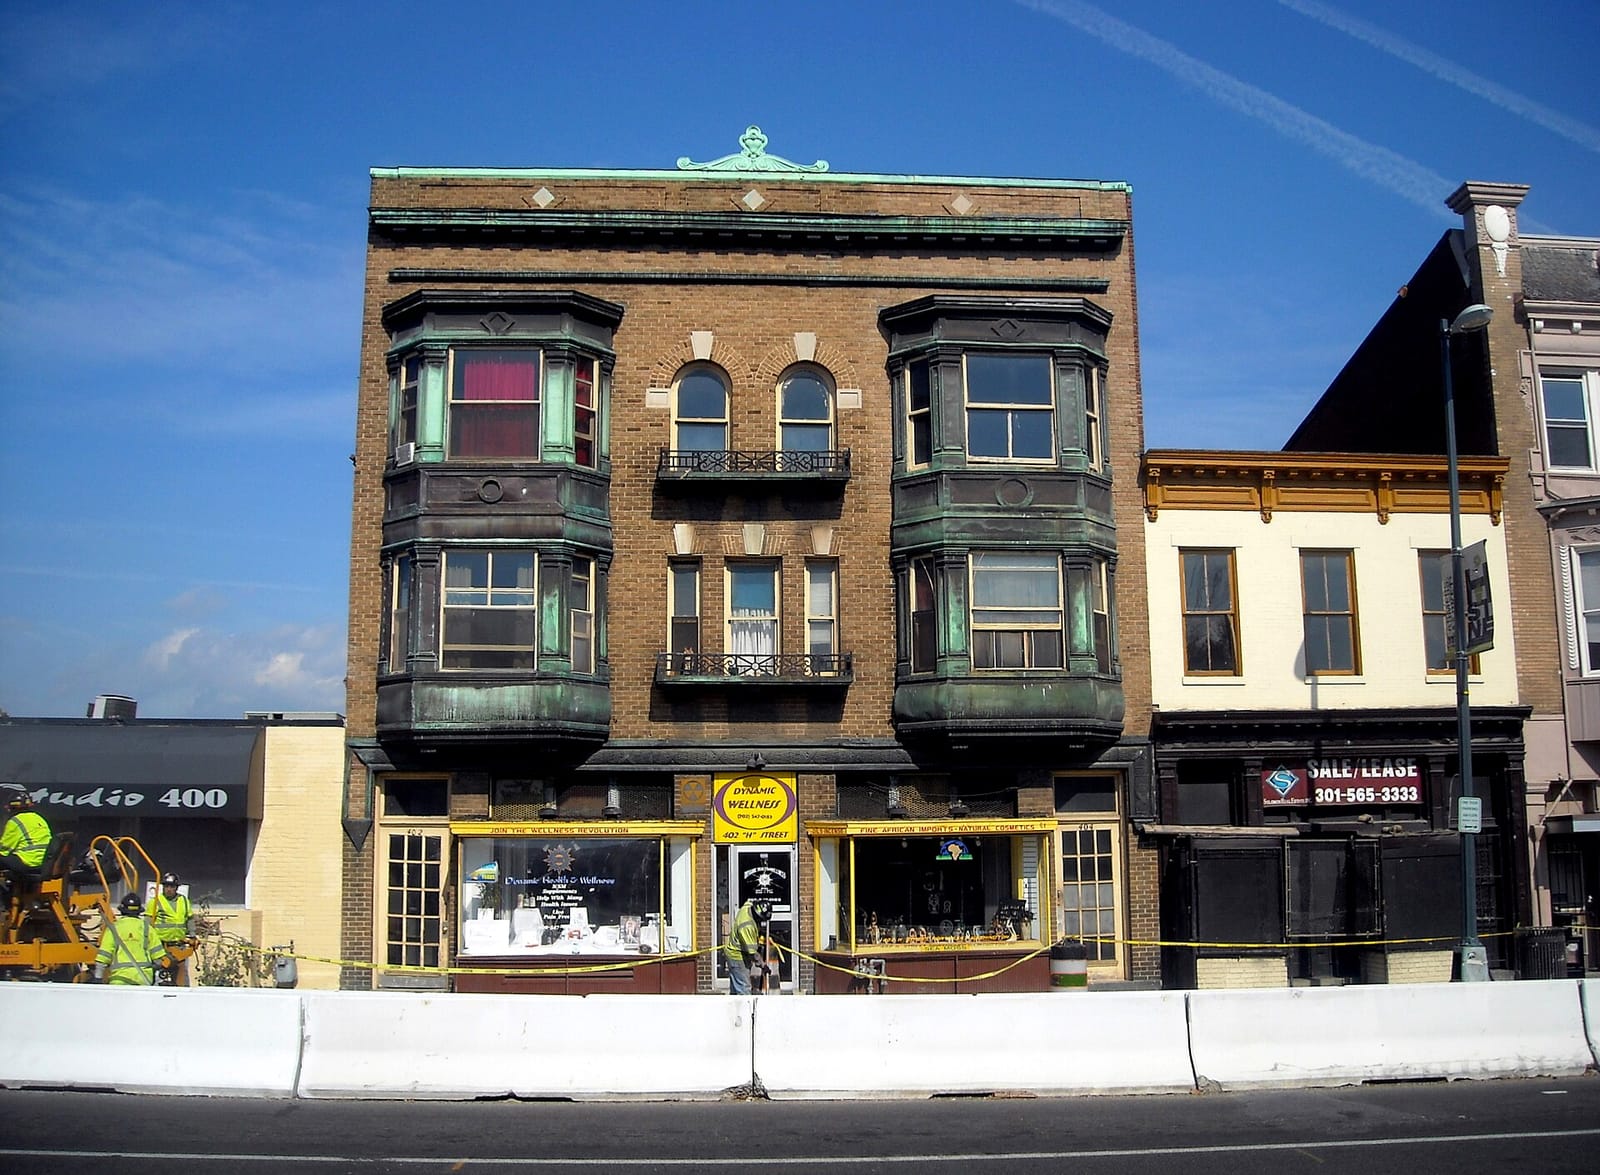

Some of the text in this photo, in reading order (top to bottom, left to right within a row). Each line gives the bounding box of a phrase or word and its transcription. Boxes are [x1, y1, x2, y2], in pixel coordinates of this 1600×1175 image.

[1307, 758, 1418, 779] SALE/LEASE
[0, 783, 228, 808] tudio 400
[733, 786, 777, 795] DYNAMIC
[1315, 786, 1418, 803] 301-565-3333
[728, 800, 782, 809] WELLNESS
[882, 826, 916, 834] AFRICAN
[995, 823, 1036, 831] COSMETICS
[722, 831, 739, 839] 402
[760, 831, 789, 839] STREET
